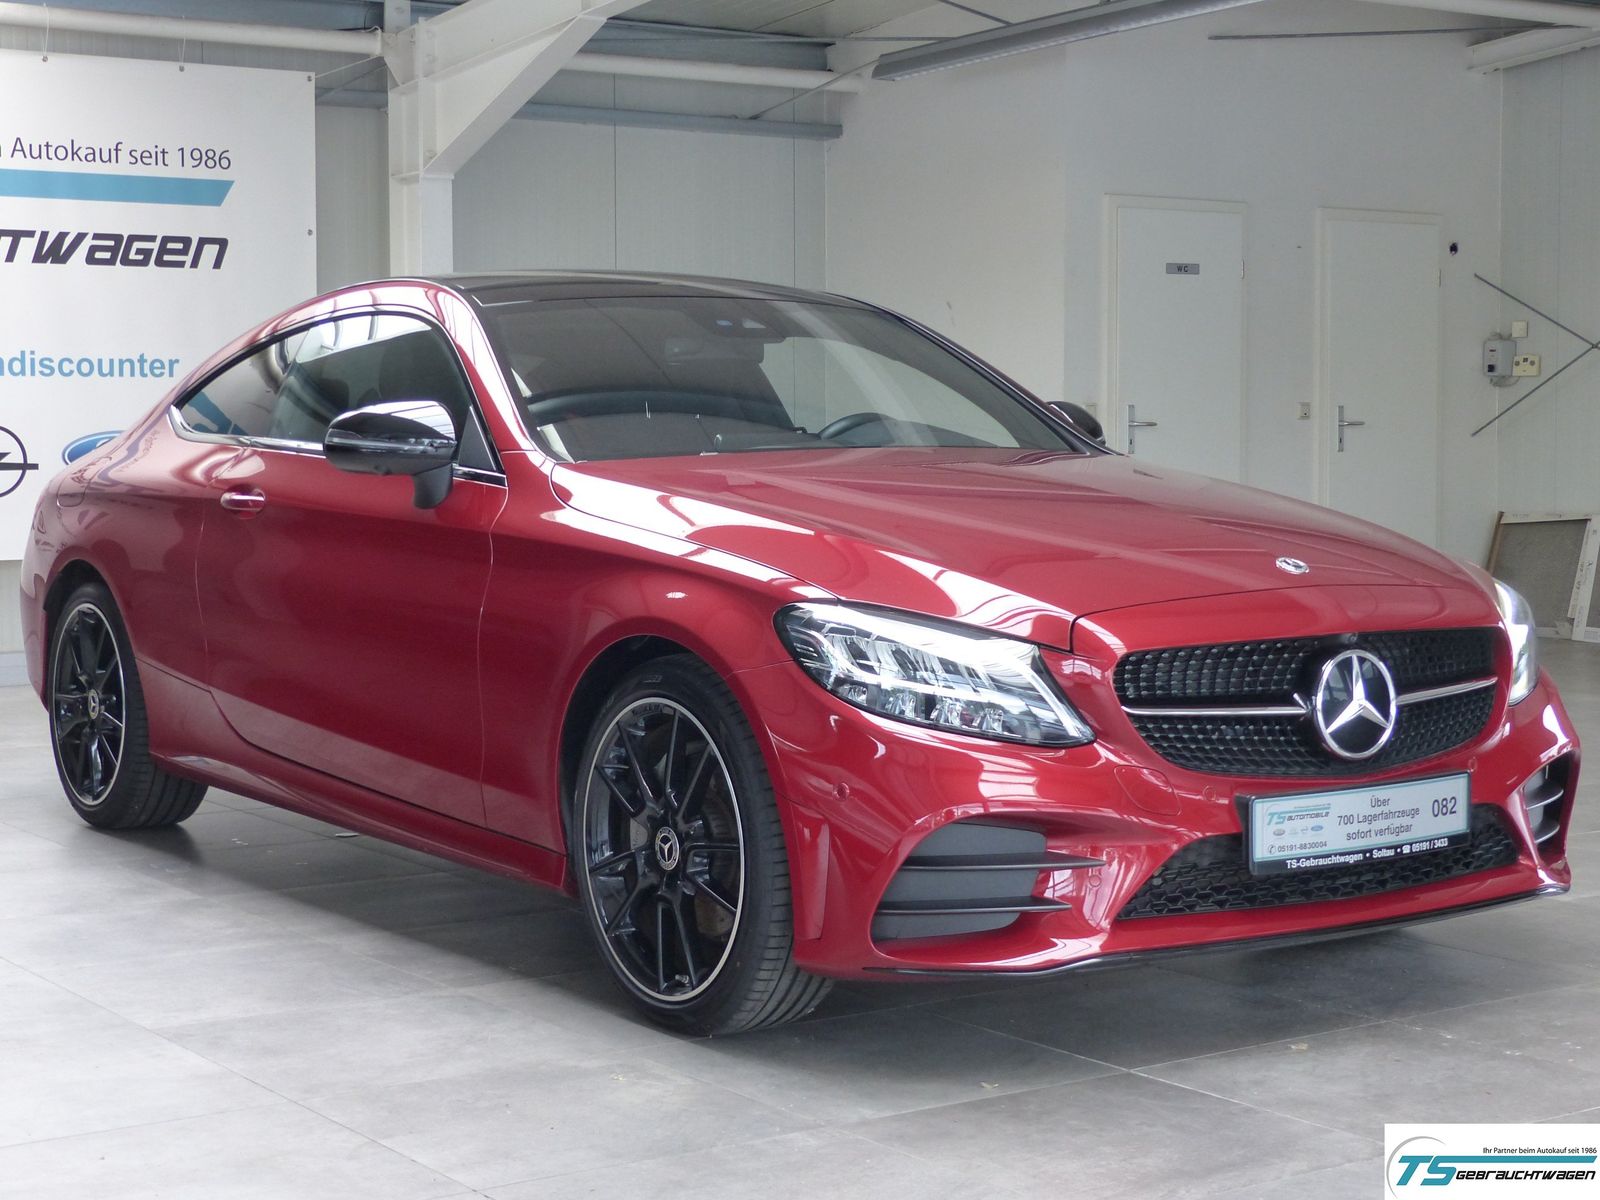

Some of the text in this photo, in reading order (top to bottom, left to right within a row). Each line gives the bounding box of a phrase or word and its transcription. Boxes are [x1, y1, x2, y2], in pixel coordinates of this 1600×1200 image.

[11, 137, 123, 165] Autokauf
[128, 144, 169, 168] seit
[177, 147, 232, 170] 1986
[1176, 265, 1188, 273] WC
[1370, 795, 1390, 808] Über
[1432, 796, 1457, 818] 082
[1267, 811, 1287, 826] TS
[1337, 807, 1421, 826] 700 Lagerfahrzeuge
[1346, 823, 1413, 841] sofort verfügbar
[1286, 853, 1363, 869] TS-Gebrauchtwagen
[1372, 848, 1395, 859] Soltau
